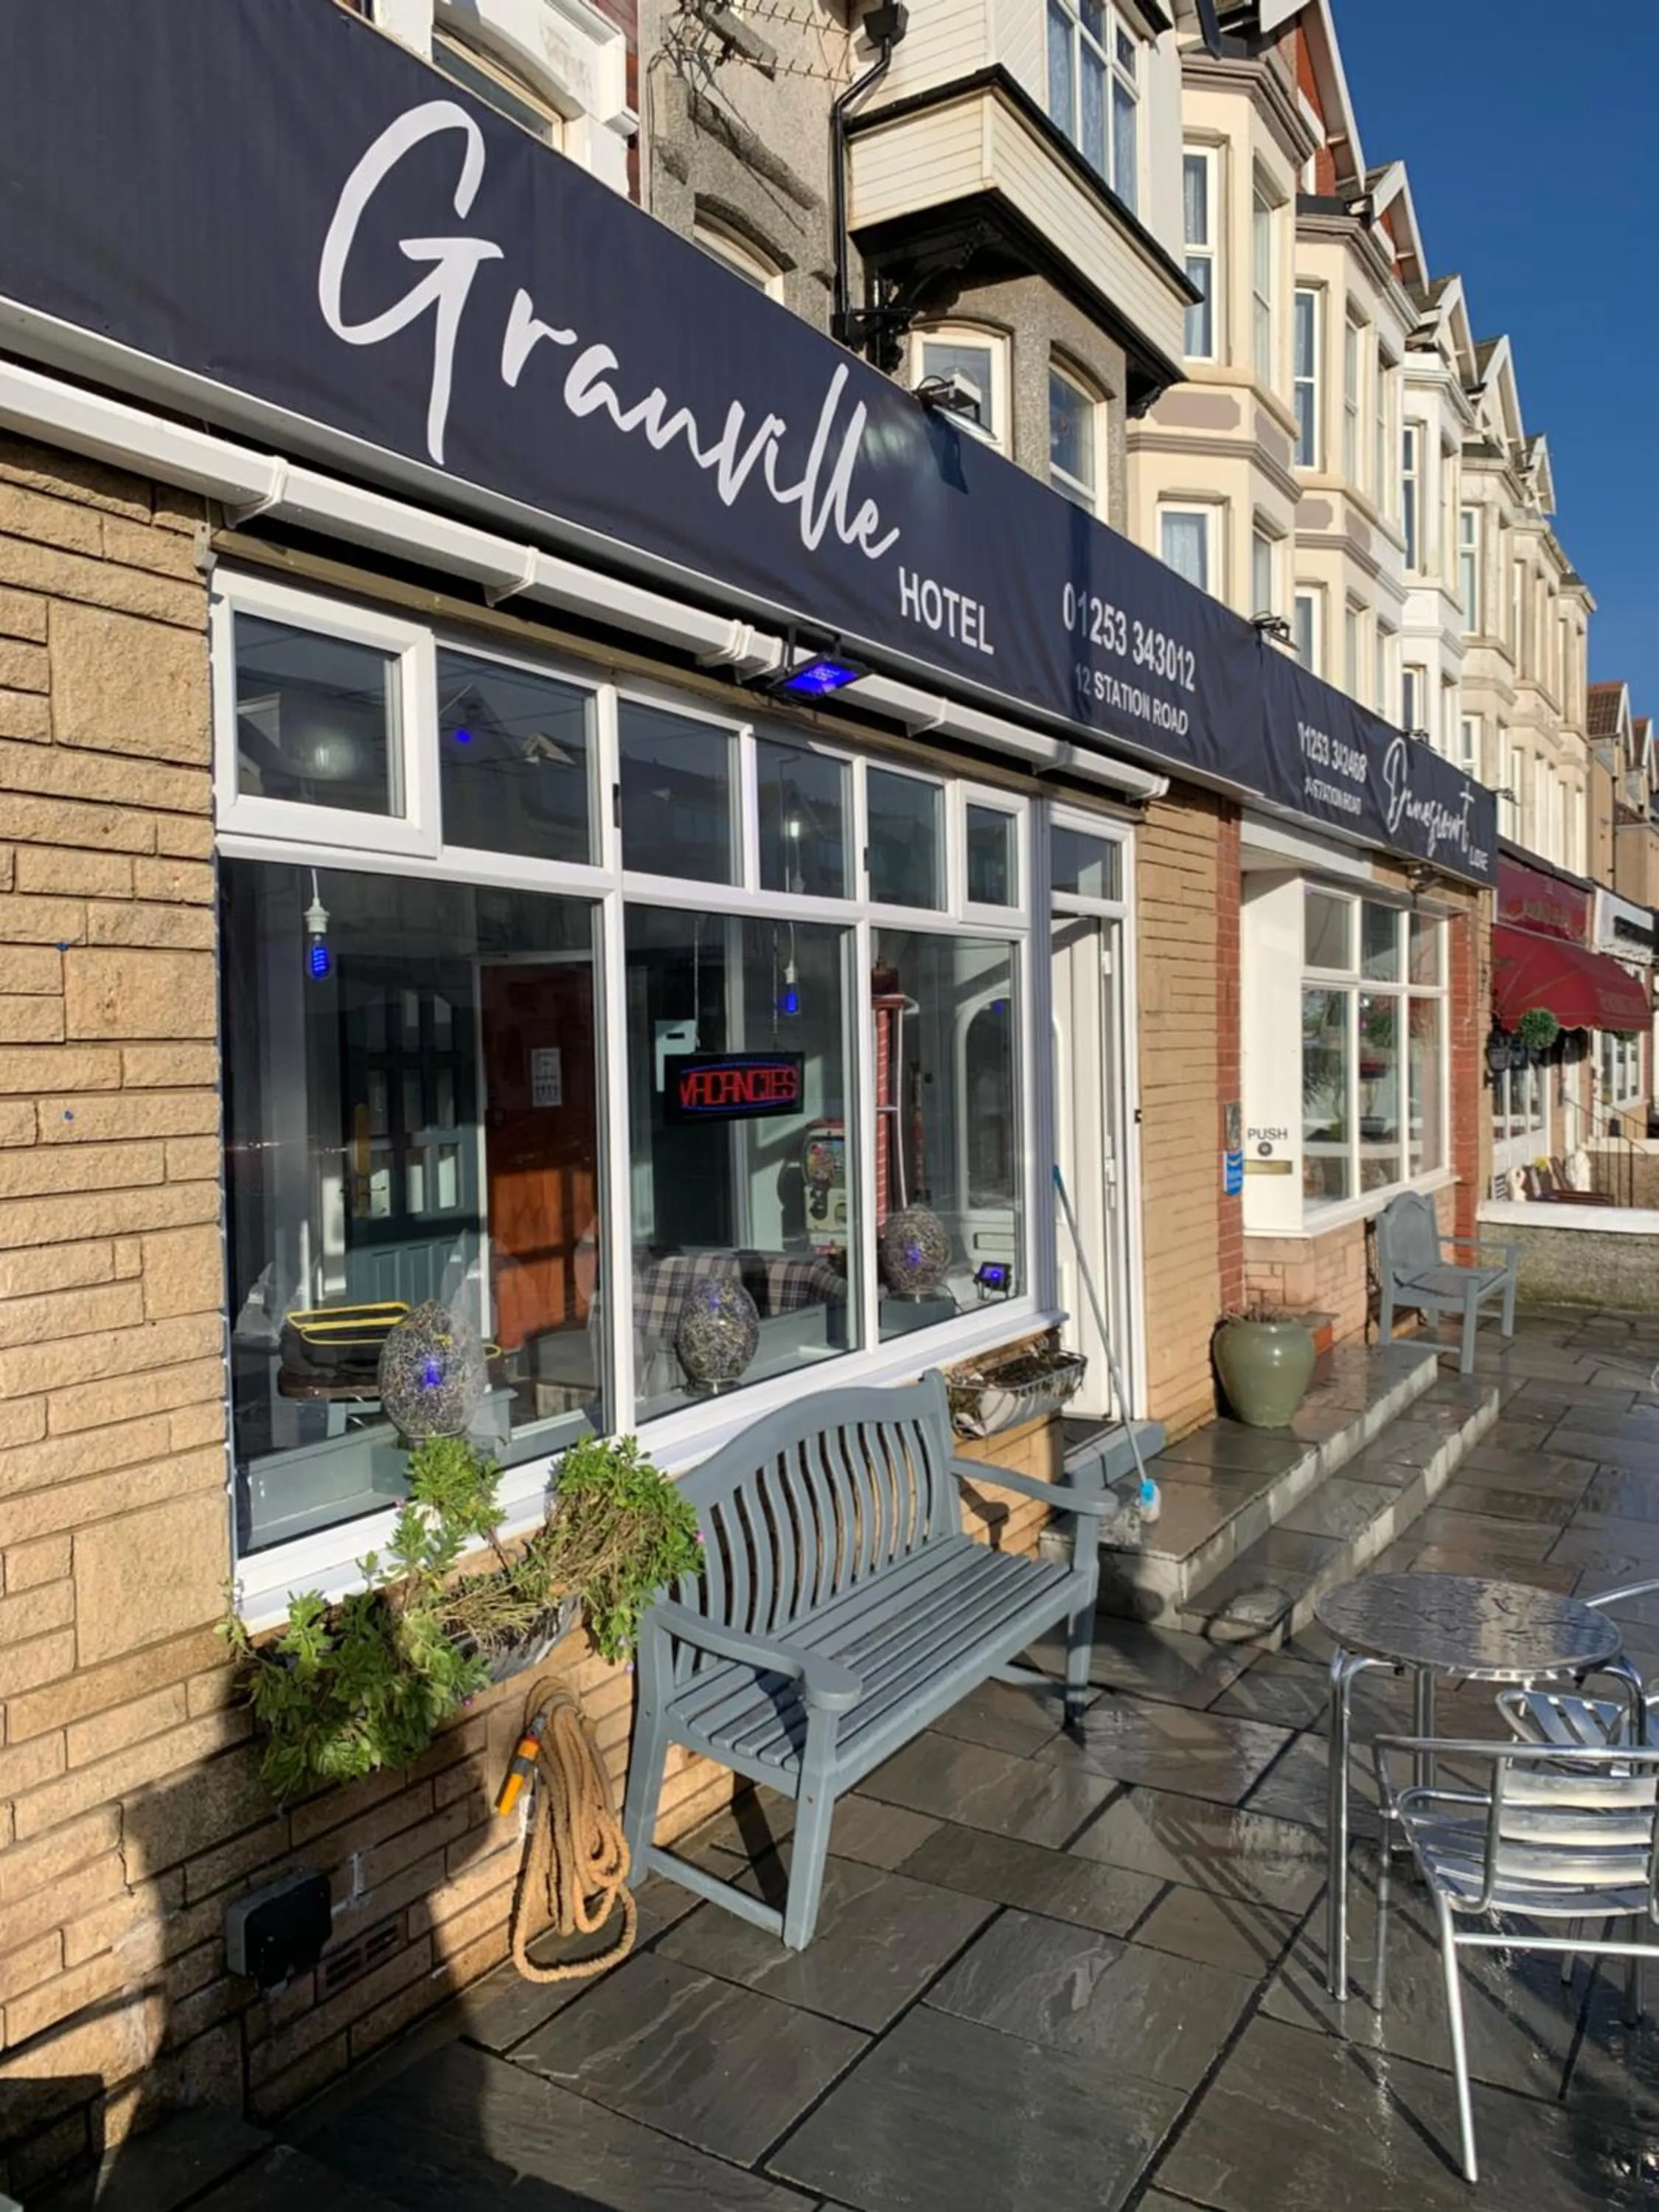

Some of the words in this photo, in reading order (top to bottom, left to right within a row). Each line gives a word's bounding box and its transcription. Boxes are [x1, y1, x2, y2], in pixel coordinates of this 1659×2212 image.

[319, 99, 900, 559] Granville
[899, 566, 995, 656] HOTEL
[1062, 581, 1127, 656] 01253
[1132, 620, 1196, 693] 343012
[1075, 662, 1091, 696] 12
[1093, 670, 1150, 721] STATION
[1152, 698, 1189, 736] ROAD
[679, 1063, 799, 1108] VACANCIES
[1248, 1128, 1288, 1140] PUSH
